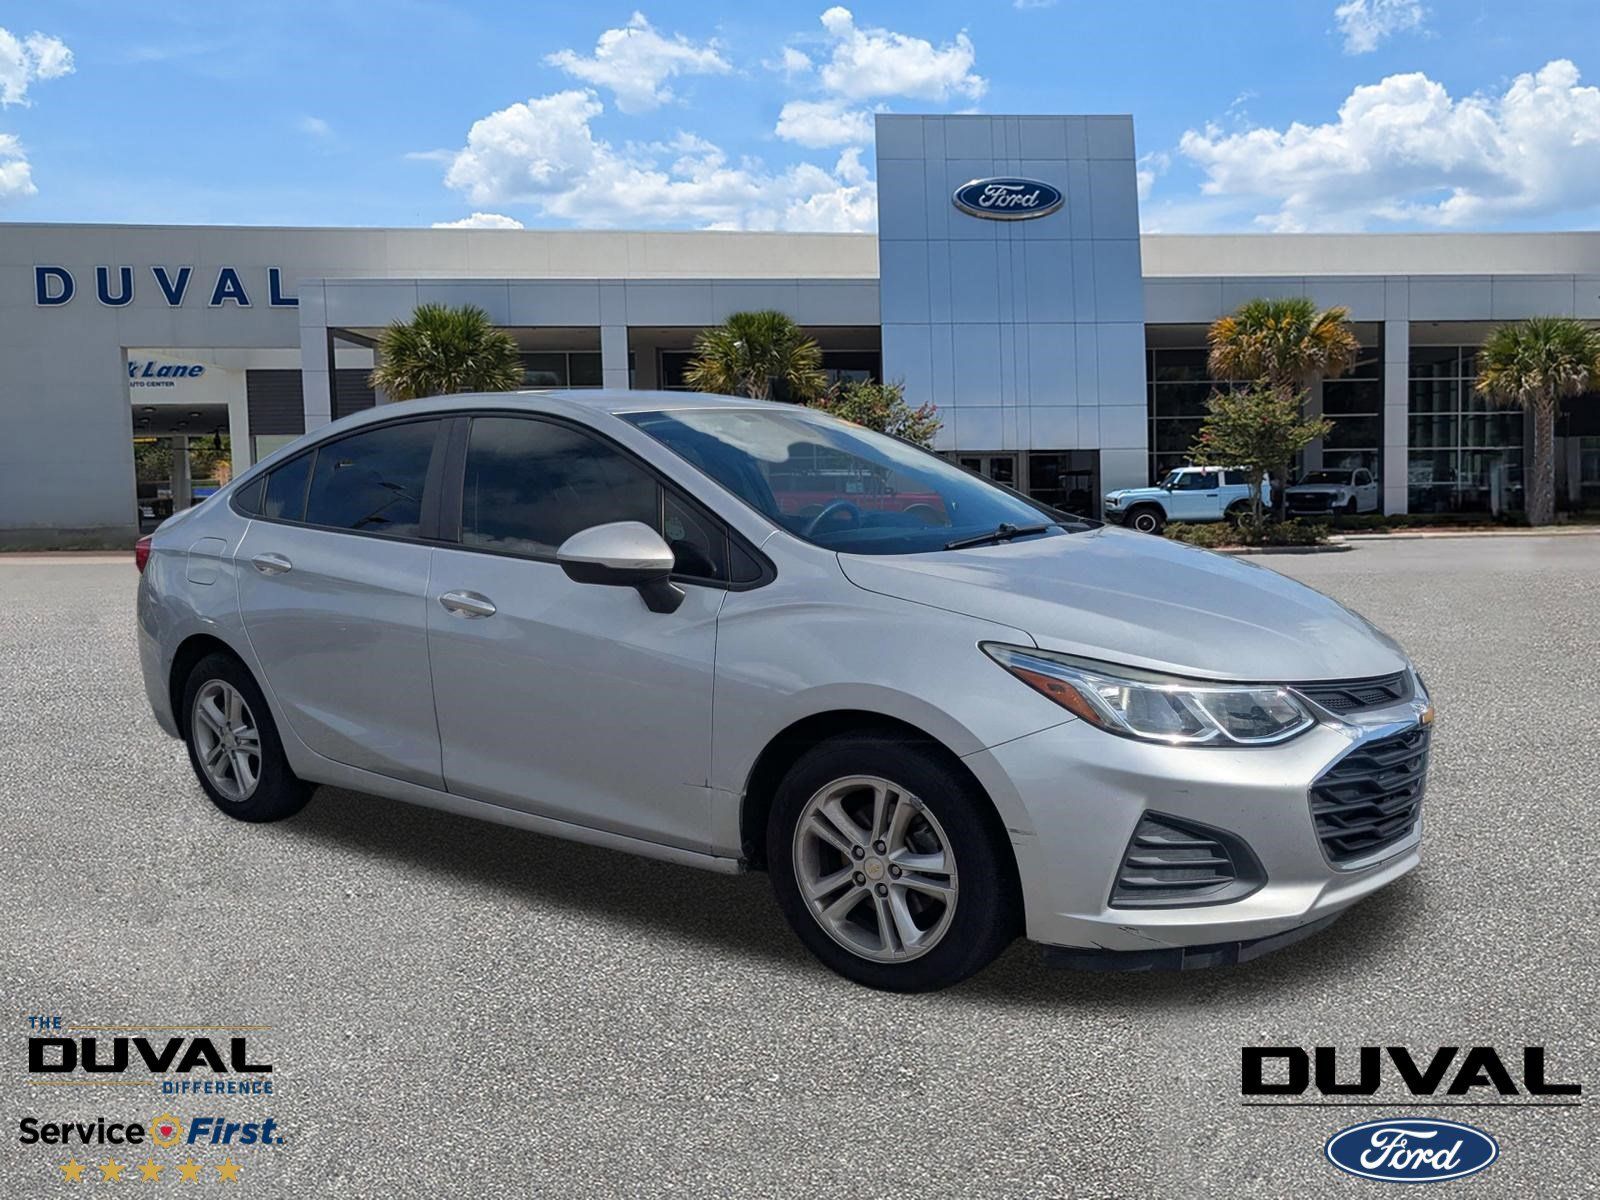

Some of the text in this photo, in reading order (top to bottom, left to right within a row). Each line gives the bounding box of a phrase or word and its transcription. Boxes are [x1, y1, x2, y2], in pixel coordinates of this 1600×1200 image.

[978, 184, 1041, 208] Ford
[33, 264, 300, 308] DUVAL
[141, 361, 206, 378] Lane
